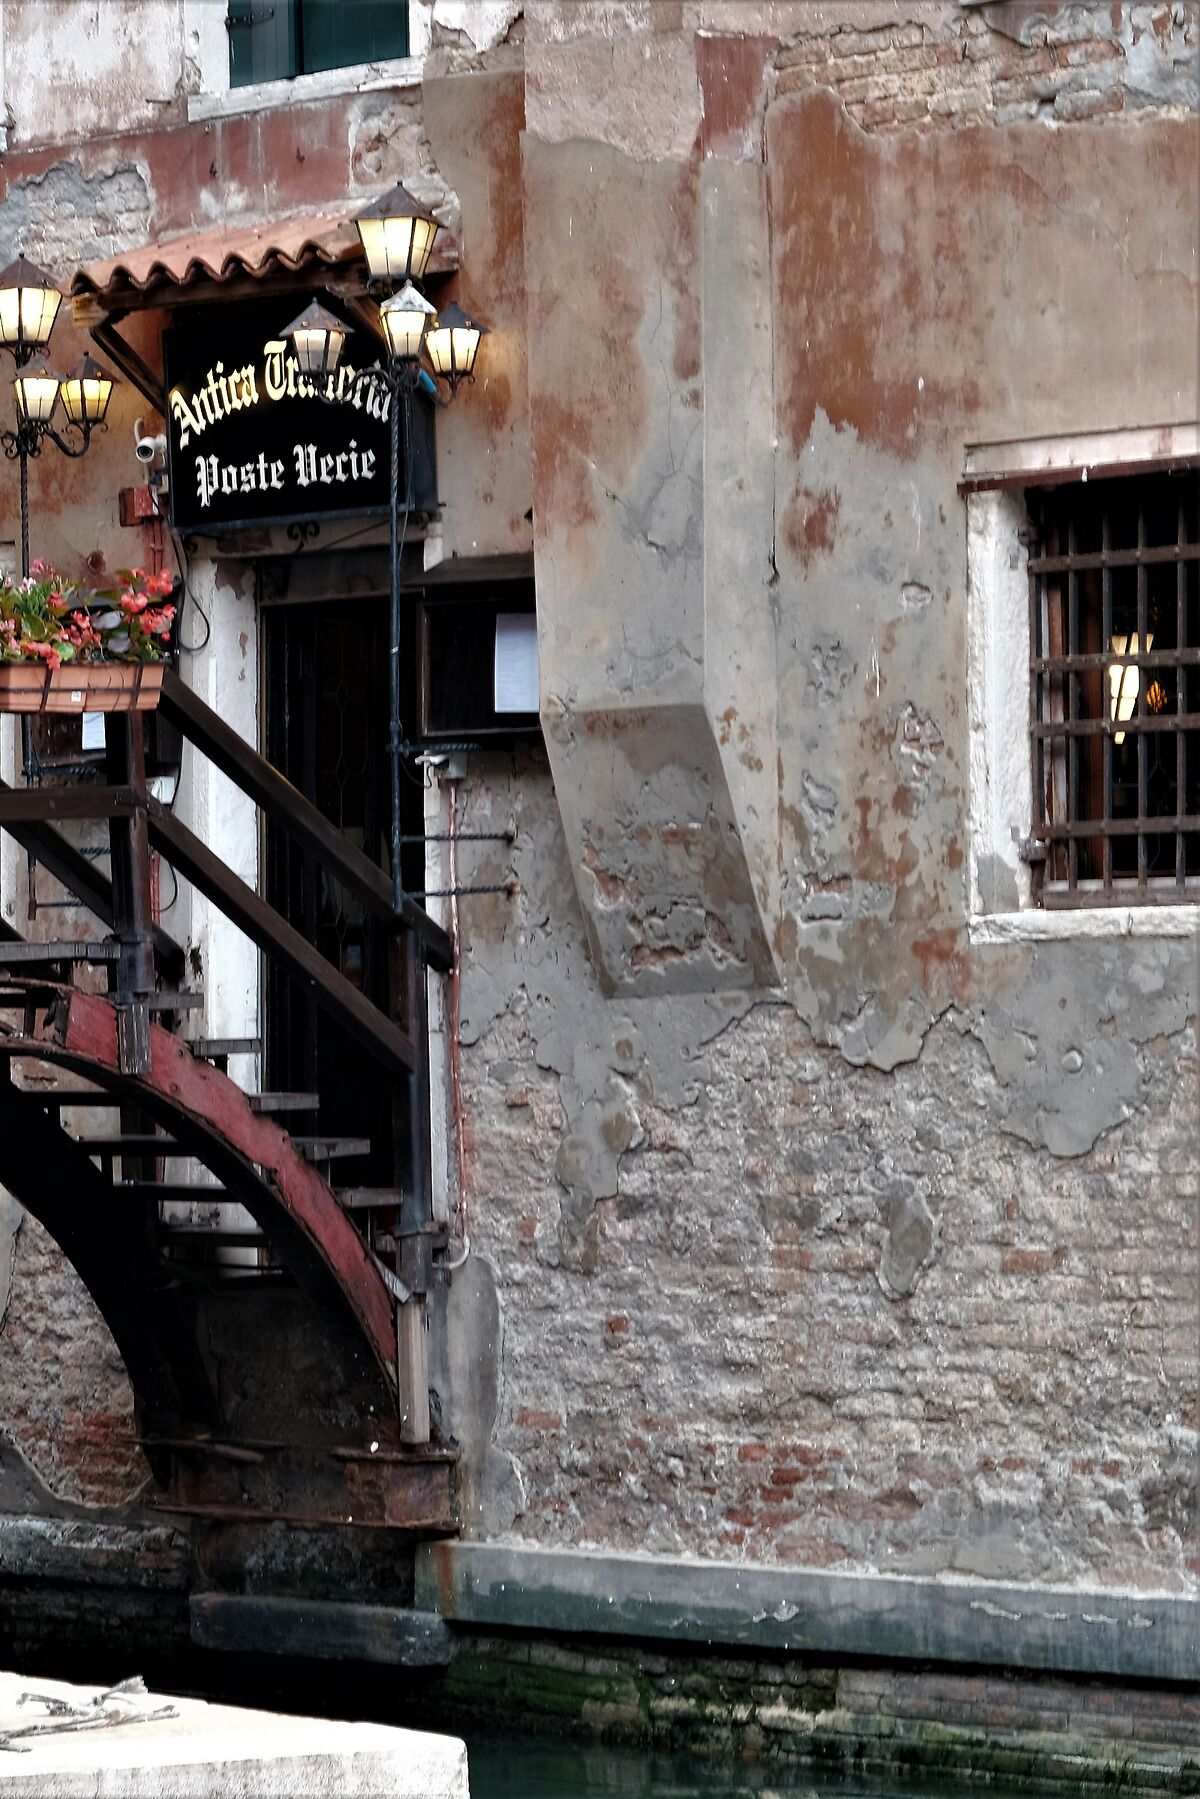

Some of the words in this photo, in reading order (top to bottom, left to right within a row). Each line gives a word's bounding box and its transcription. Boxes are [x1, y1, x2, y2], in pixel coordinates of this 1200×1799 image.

[171, 361, 259, 450] Antica
[263, 340, 391, 423] Tratoria
[195, 452, 285, 507] Poste
[293, 439, 376, 487] Vecie
